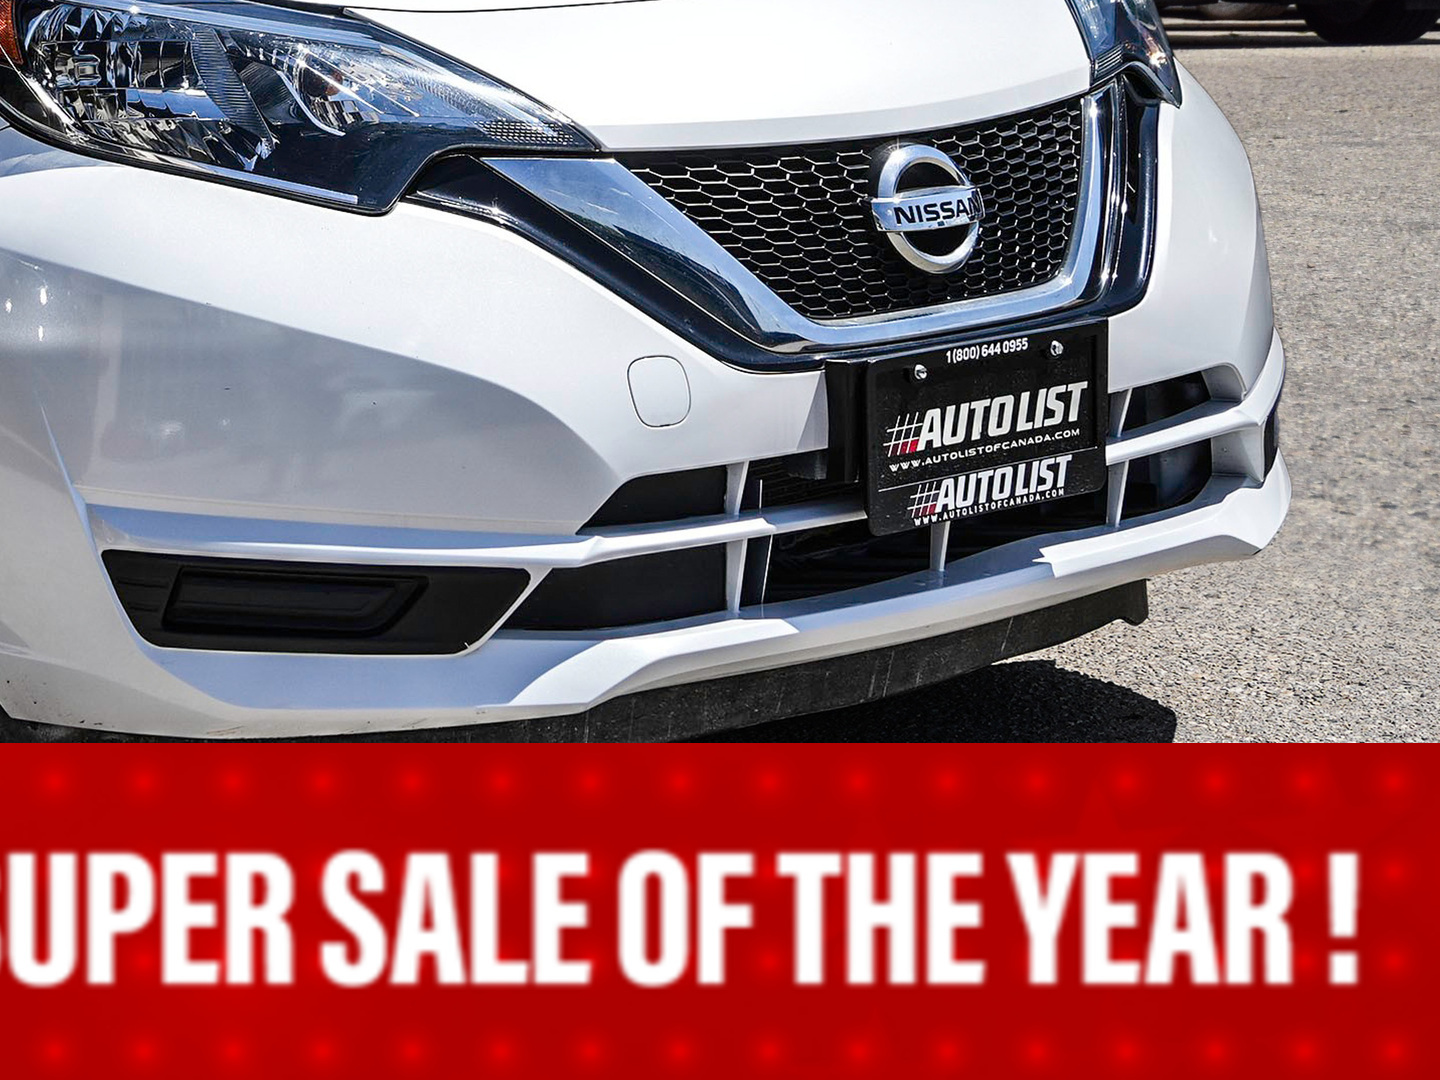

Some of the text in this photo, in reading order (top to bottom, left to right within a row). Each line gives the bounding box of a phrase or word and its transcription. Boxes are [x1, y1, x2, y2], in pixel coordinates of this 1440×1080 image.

[893, 195, 982, 224] NISSAN
[981, 342, 1001, 357] 644
[1002, 337, 1028, 354] 0955
[913, 488, 1065, 526] WWW.AUTOLISTOFCANADA.COM
